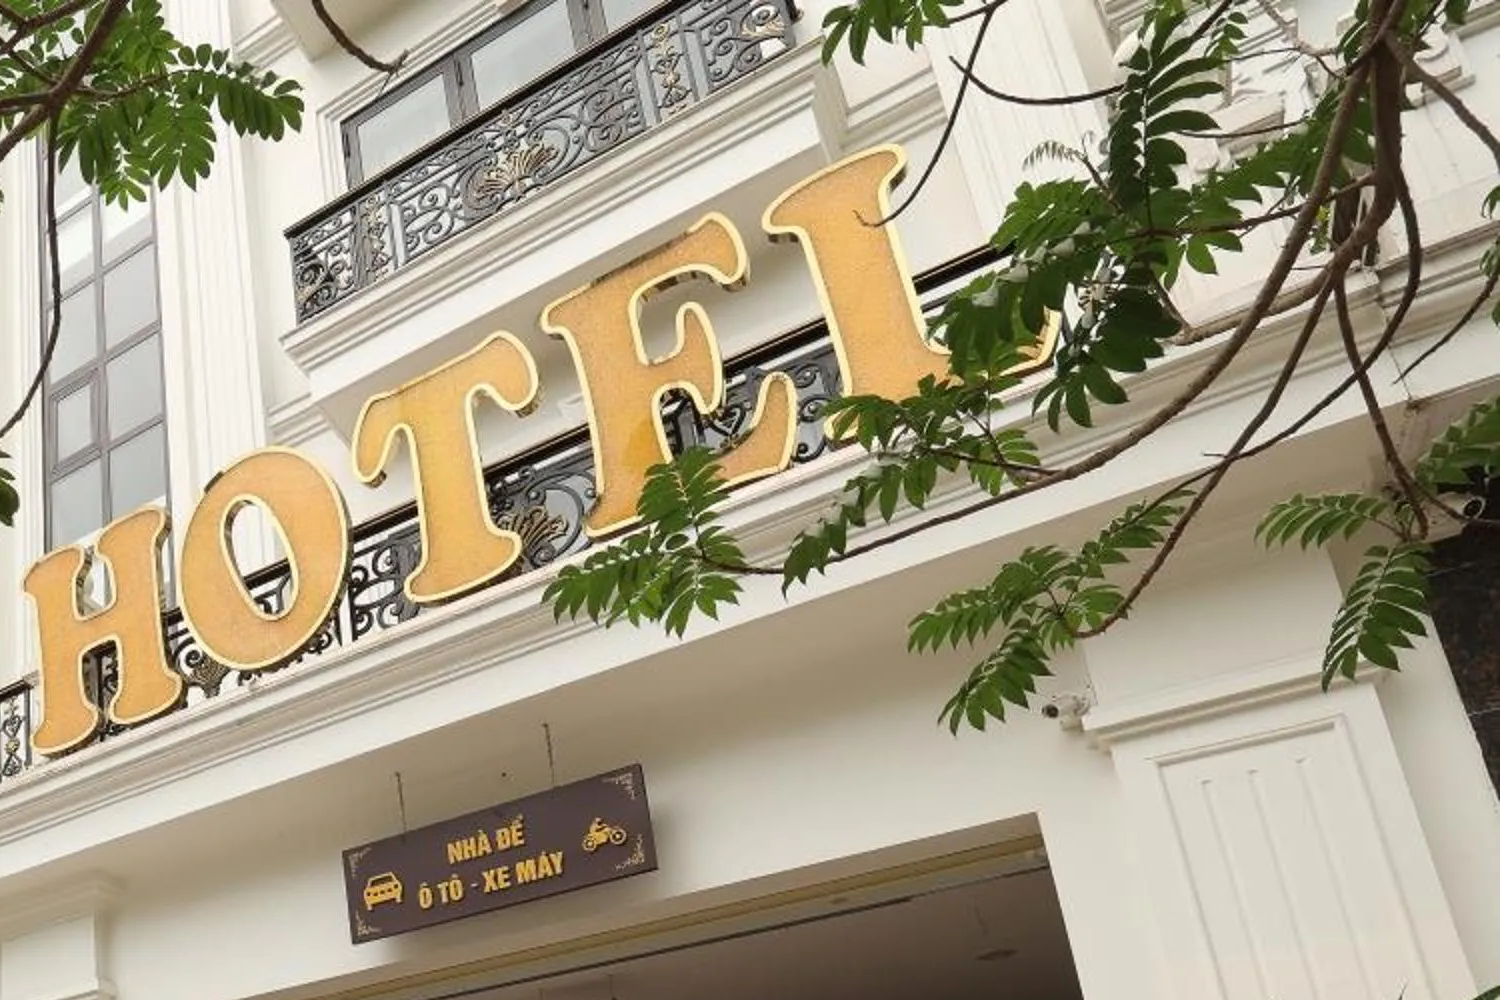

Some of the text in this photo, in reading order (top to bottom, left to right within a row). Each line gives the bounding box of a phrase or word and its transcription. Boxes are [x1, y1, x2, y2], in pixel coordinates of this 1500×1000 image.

[20, 142, 1066, 758] HOTEL
[446, 829, 492, 865] NHÀ
[418, 881, 433, 909] Ô
[437, 873, 464, 903] TÔ
[482, 866, 511, 894] XE
[515, 851, 565, 884] MÁY
